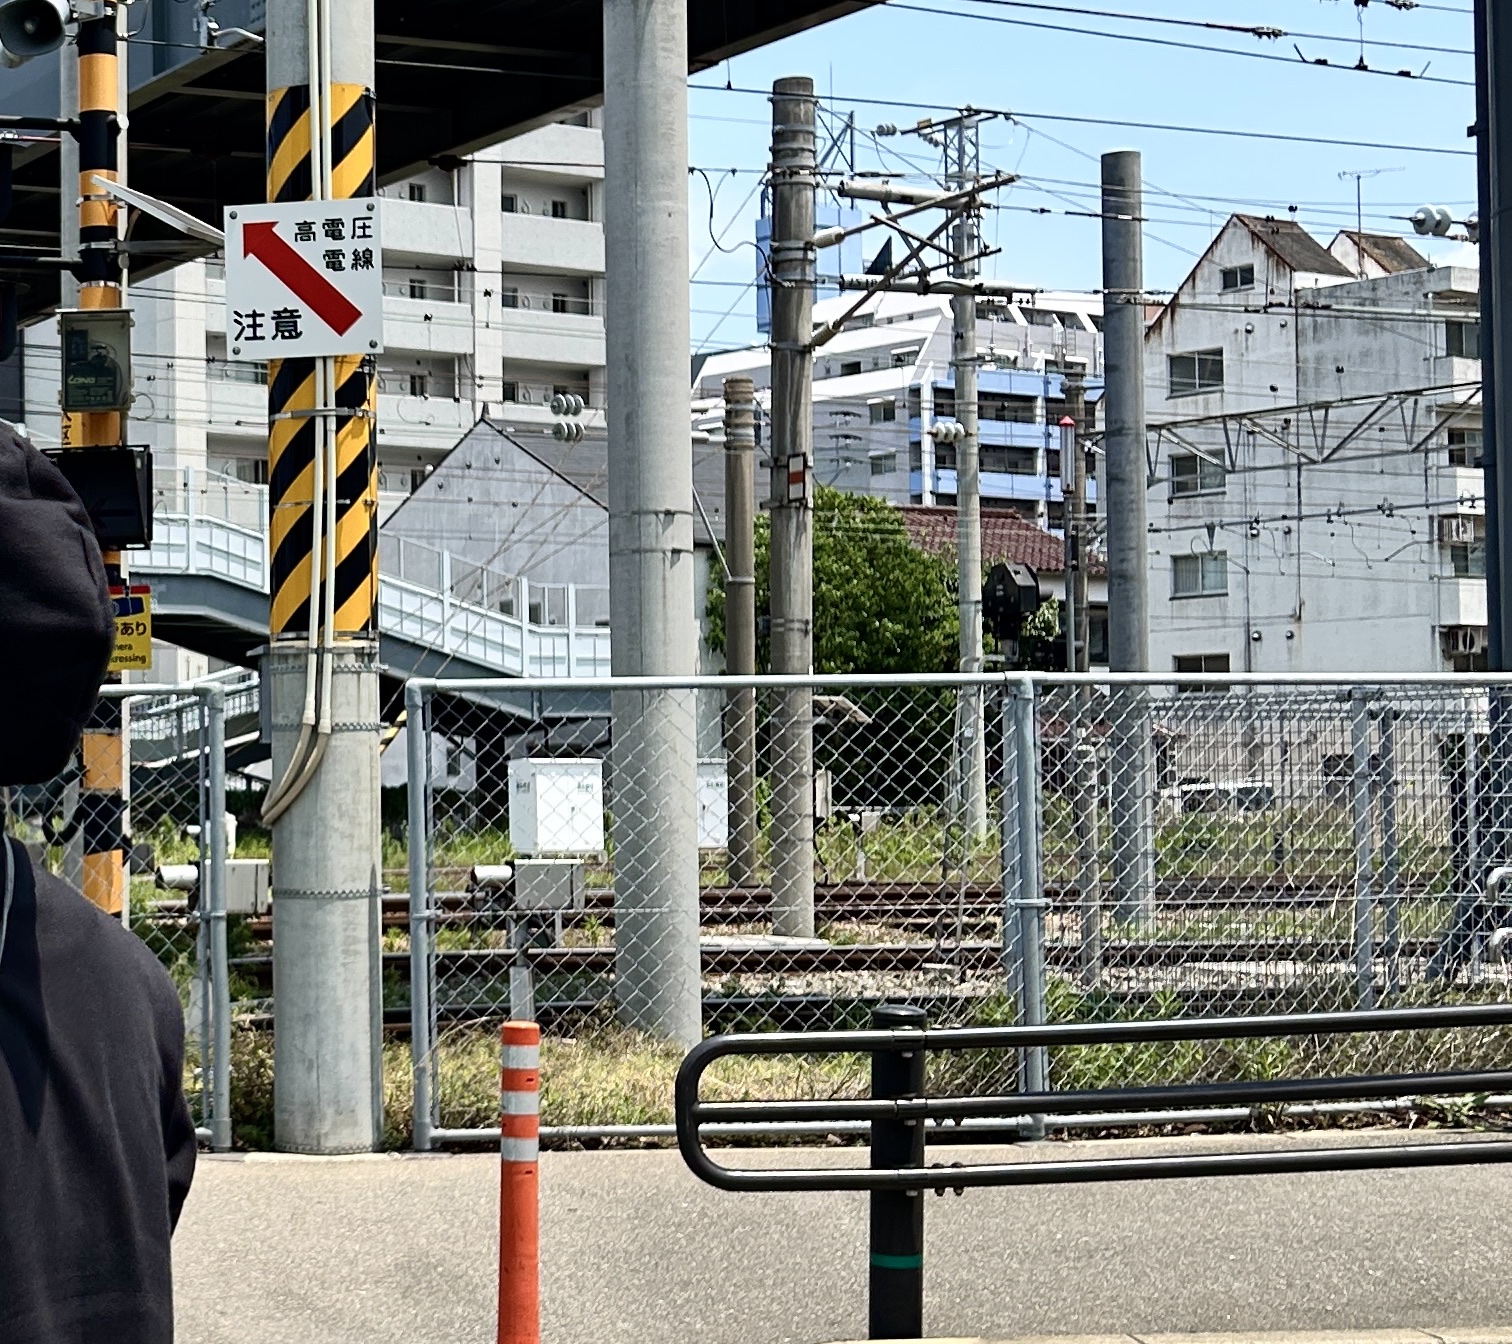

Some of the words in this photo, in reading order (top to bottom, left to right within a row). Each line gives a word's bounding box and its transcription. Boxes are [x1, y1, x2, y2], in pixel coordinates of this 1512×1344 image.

[294, 216, 374, 243] 高電圧
[322, 247, 375, 272] 電線
[233, 307, 303, 342] 注意
[115, 621, 147, 636] あり
